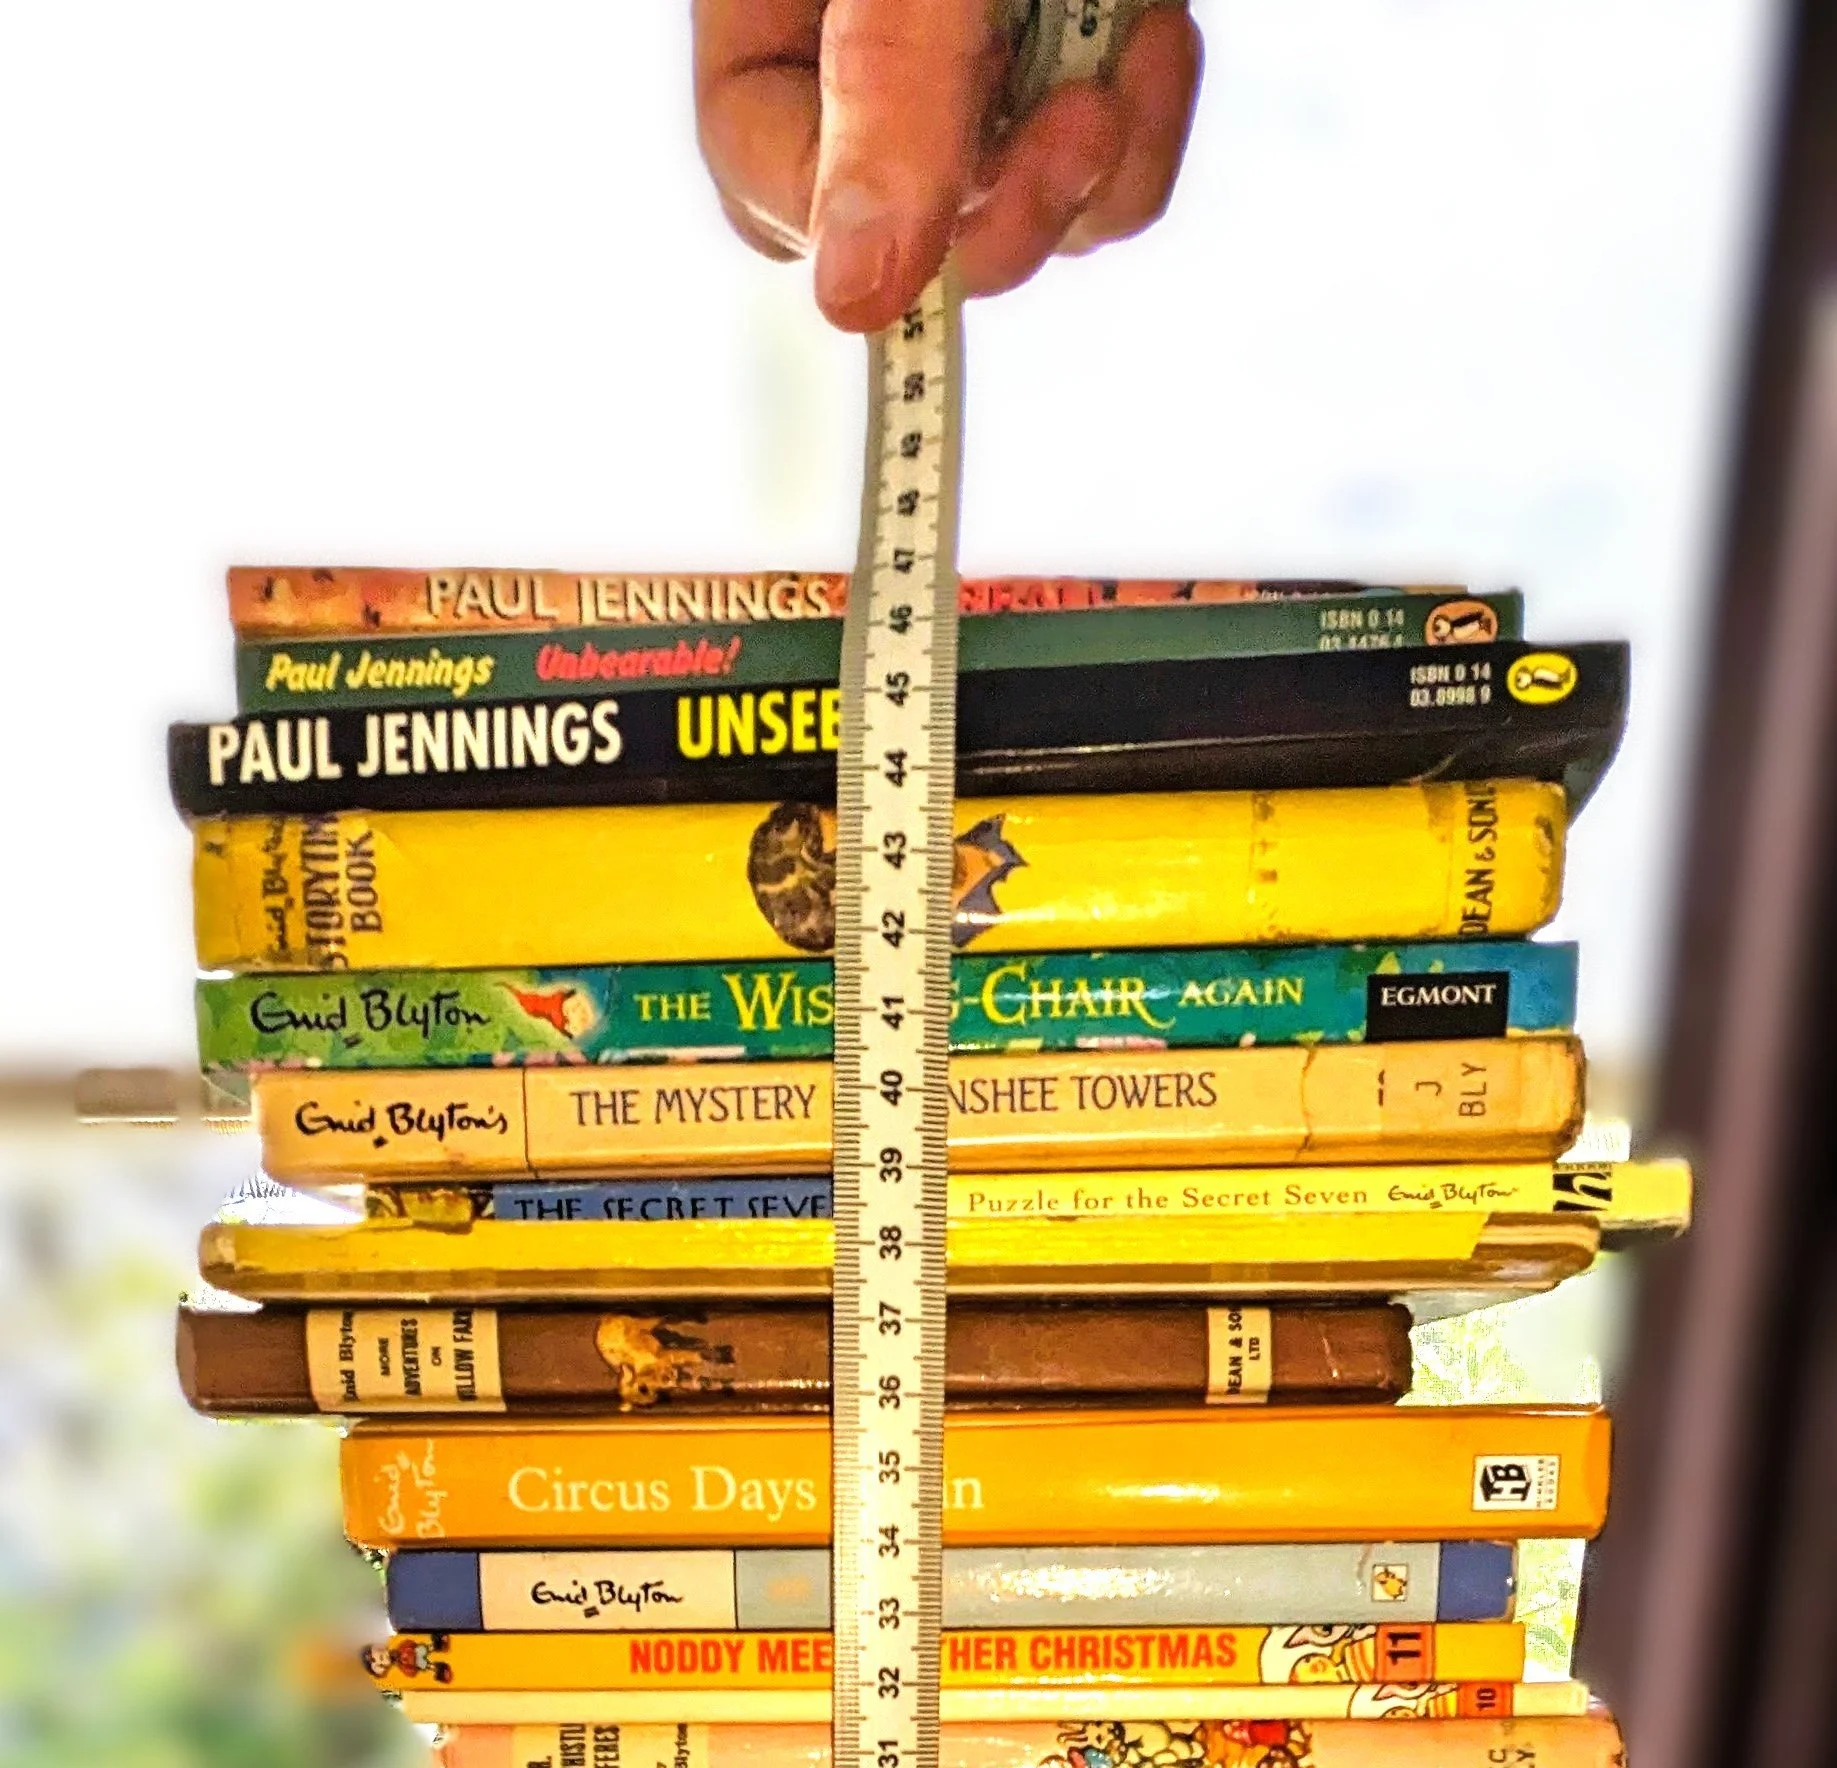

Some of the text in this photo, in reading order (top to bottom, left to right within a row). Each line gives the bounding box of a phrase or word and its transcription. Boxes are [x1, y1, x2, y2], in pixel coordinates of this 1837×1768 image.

[425, 574, 830, 625] PAUL JENNINGS
[265, 650, 493, 697] Paul Jennings
[536, 638, 740, 681] Unbearable!
[1410, 663, 1491, 687] ISBN 14
[676, 689, 841, 758] UNSEE
[207, 701, 620, 785] PAUL JENNINGS
[883, 831, 907, 870] 43
[346, 831, 382, 931] BOOK
[1458, 868, 1494, 935] DEAN
[882, 910, 905, 948] 42
[251, 988, 490, 1040] Enid Blyton
[635, 978, 1305, 1020] THE AGAIN
[1381, 984, 1495, 1007] EGMONT
[570, 1071, 1218, 1127] THE MYSTERY NSHEE TOWERS
[880, 1070, 903, 1107] 40
[1458, 1061, 1487, 1117] BLY
[294, 1102, 508, 1145] Enid Blyton's
[879, 1147, 902, 1184] 39
[514, 1197, 728, 1220] THE SECRET
[967, 1185, 1368, 1215] Puzzle for the Secret Seven
[1387, 1182, 1520, 1208] Enid Blyton
[879, 1301, 901, 1336] 37
[378, 1337, 391, 1376] MORE
[400, 1318, 422, 1396] ADVENTURES
[431, 1346, 442, 1366] ON
[1249, 1337, 1260, 1360] LTD
[879, 1374, 901, 1409] 36
[508, 1466, 817, 1523] Circus Days
[879, 1524, 900, 1558] 34
[532, 1580, 684, 1611] Enid Blyton
[879, 1597, 900, 1631] 33
[630, 1632, 1238, 1674] NODDY MEE CHRISTMAS
[1388, 1632, 1421, 1665] 11
[1477, 1687, 1496, 1711] 10
[877, 1739, 899, 1768] 31
